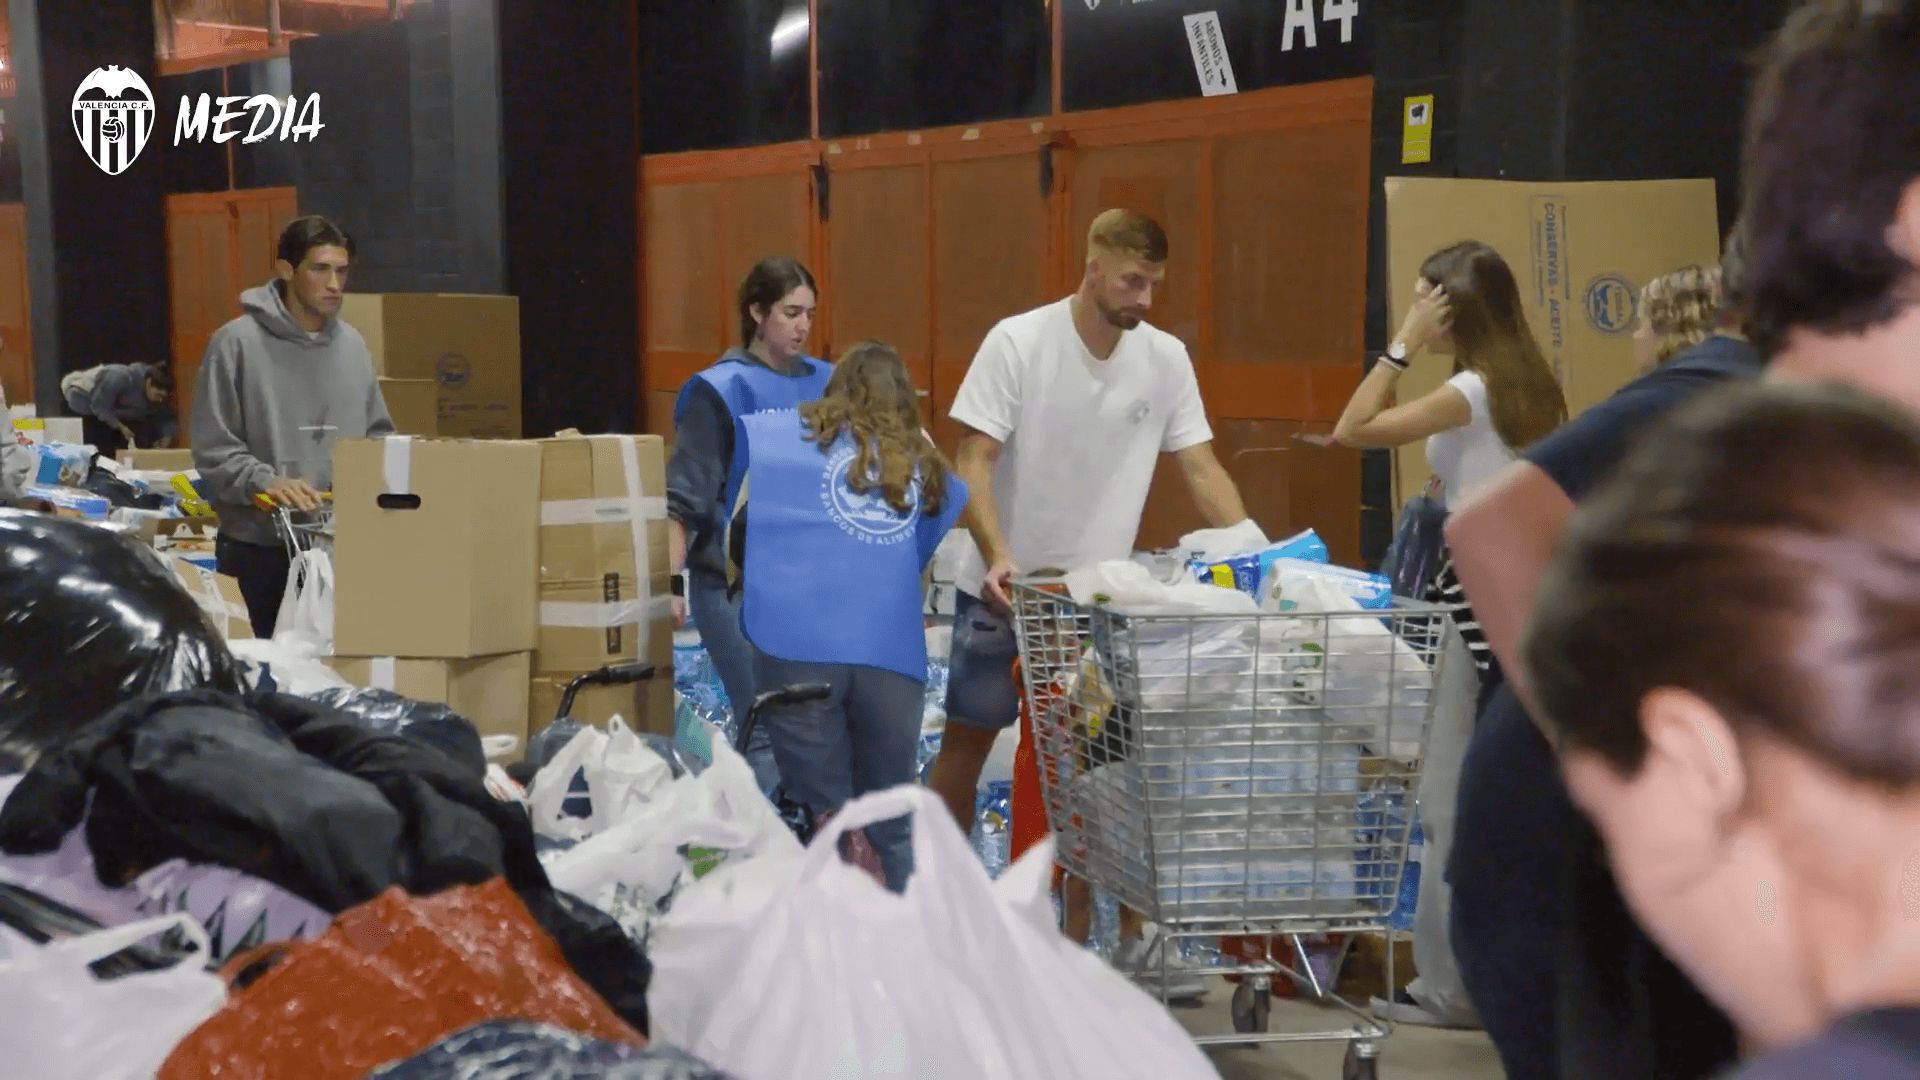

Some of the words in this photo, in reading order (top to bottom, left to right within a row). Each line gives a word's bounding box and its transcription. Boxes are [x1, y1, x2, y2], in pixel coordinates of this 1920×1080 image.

[1204, 19, 1223, 67] ABONOS
[1281, 0, 1359, 52] A4
[1191, 20, 1213, 87] INFANTILES
[1544, 202, 1558, 286] CONSERVAS
[857, 531, 873, 545] DE
